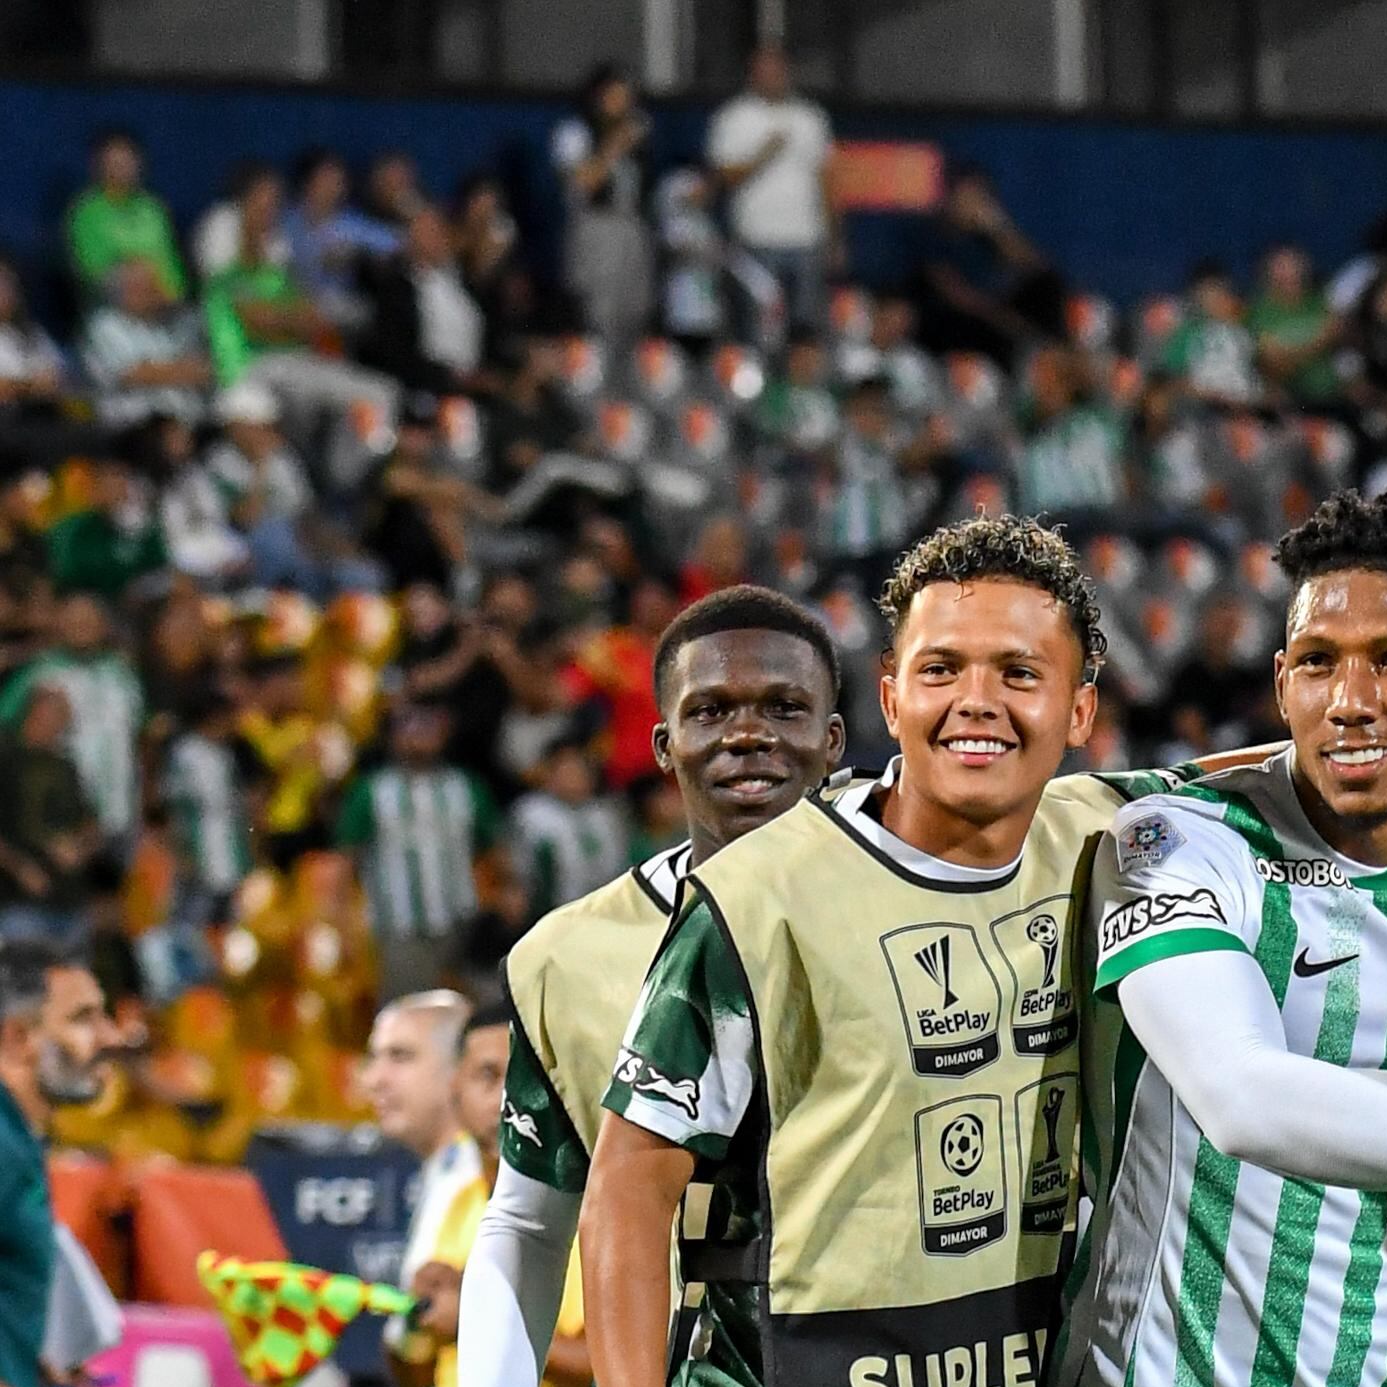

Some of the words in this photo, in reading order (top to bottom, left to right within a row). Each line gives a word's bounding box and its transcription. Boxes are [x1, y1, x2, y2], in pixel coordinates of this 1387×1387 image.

[1103, 896, 1152, 951] TVS
[1021, 988, 1072, 1017] BetPlay
[920, 1010, 990, 1037] BetPlay
[935, 1048, 984, 1069] DIMAYOR
[933, 1188, 994, 1216] BetPlay
[940, 1226, 987, 1247] DIMAYOR
